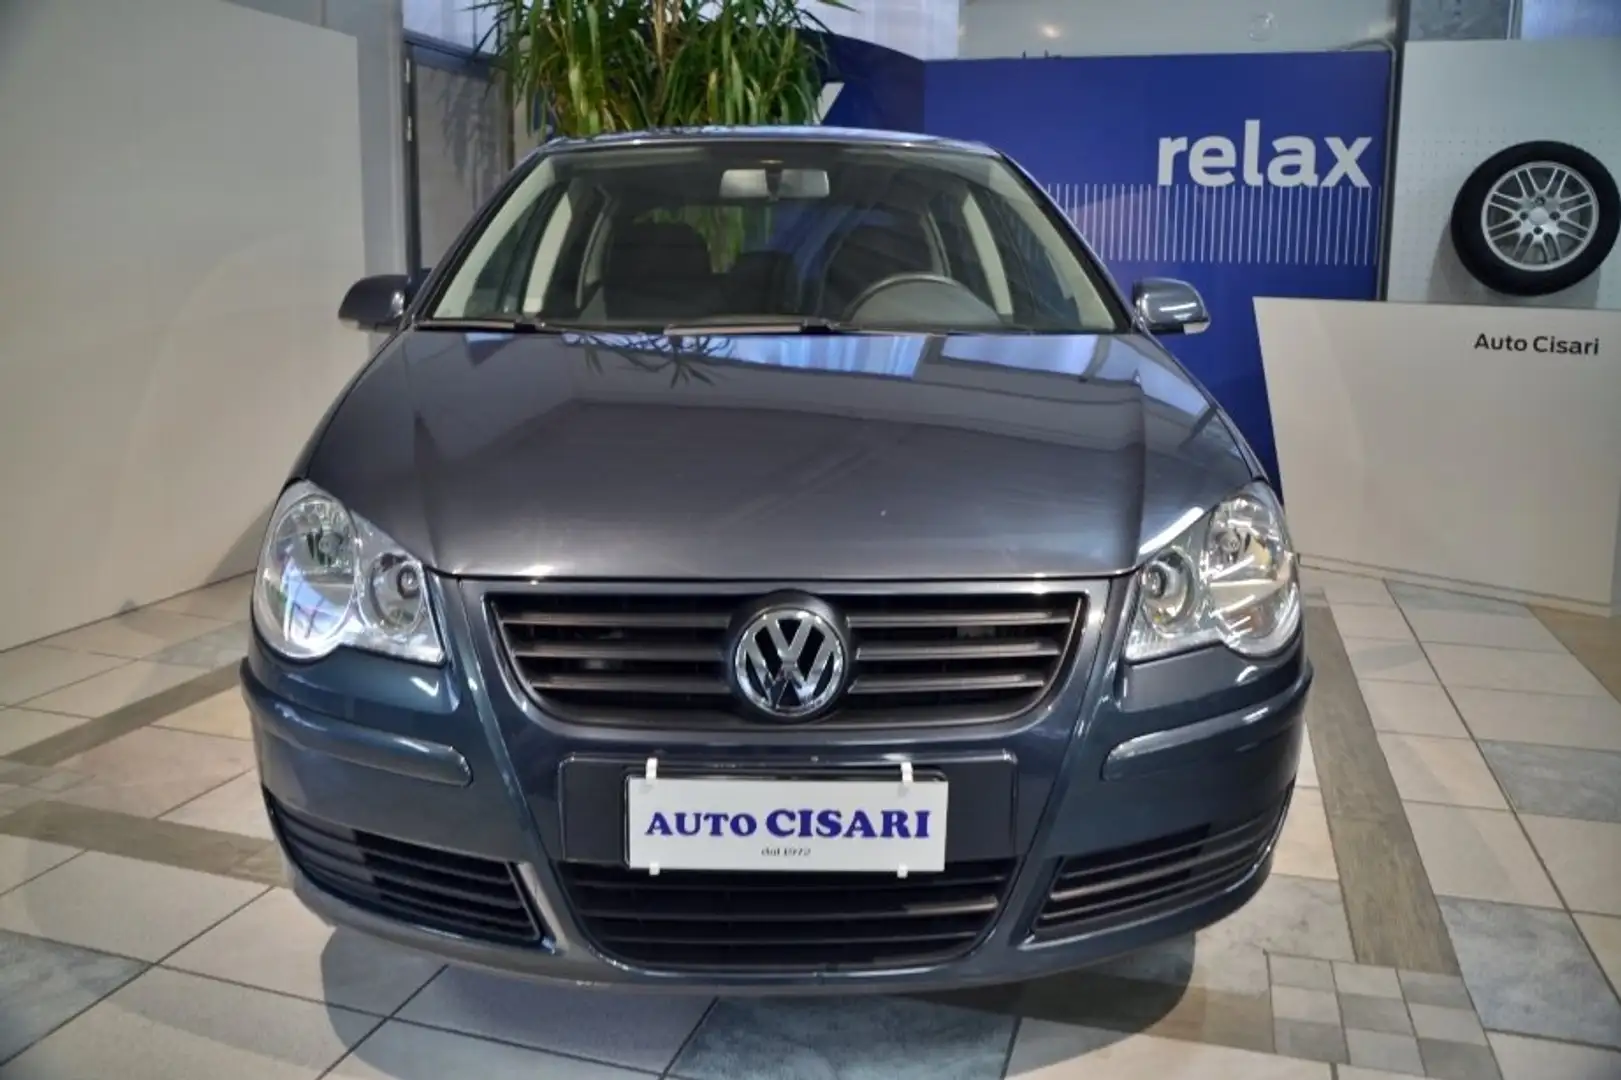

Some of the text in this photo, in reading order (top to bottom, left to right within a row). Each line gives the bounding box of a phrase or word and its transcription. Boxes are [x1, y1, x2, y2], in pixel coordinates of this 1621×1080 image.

[1157, 119, 1373, 188] relax
[1474, 332, 1600, 356] Auto Cisari
[645, 809, 931, 839] AUTO CISARI
